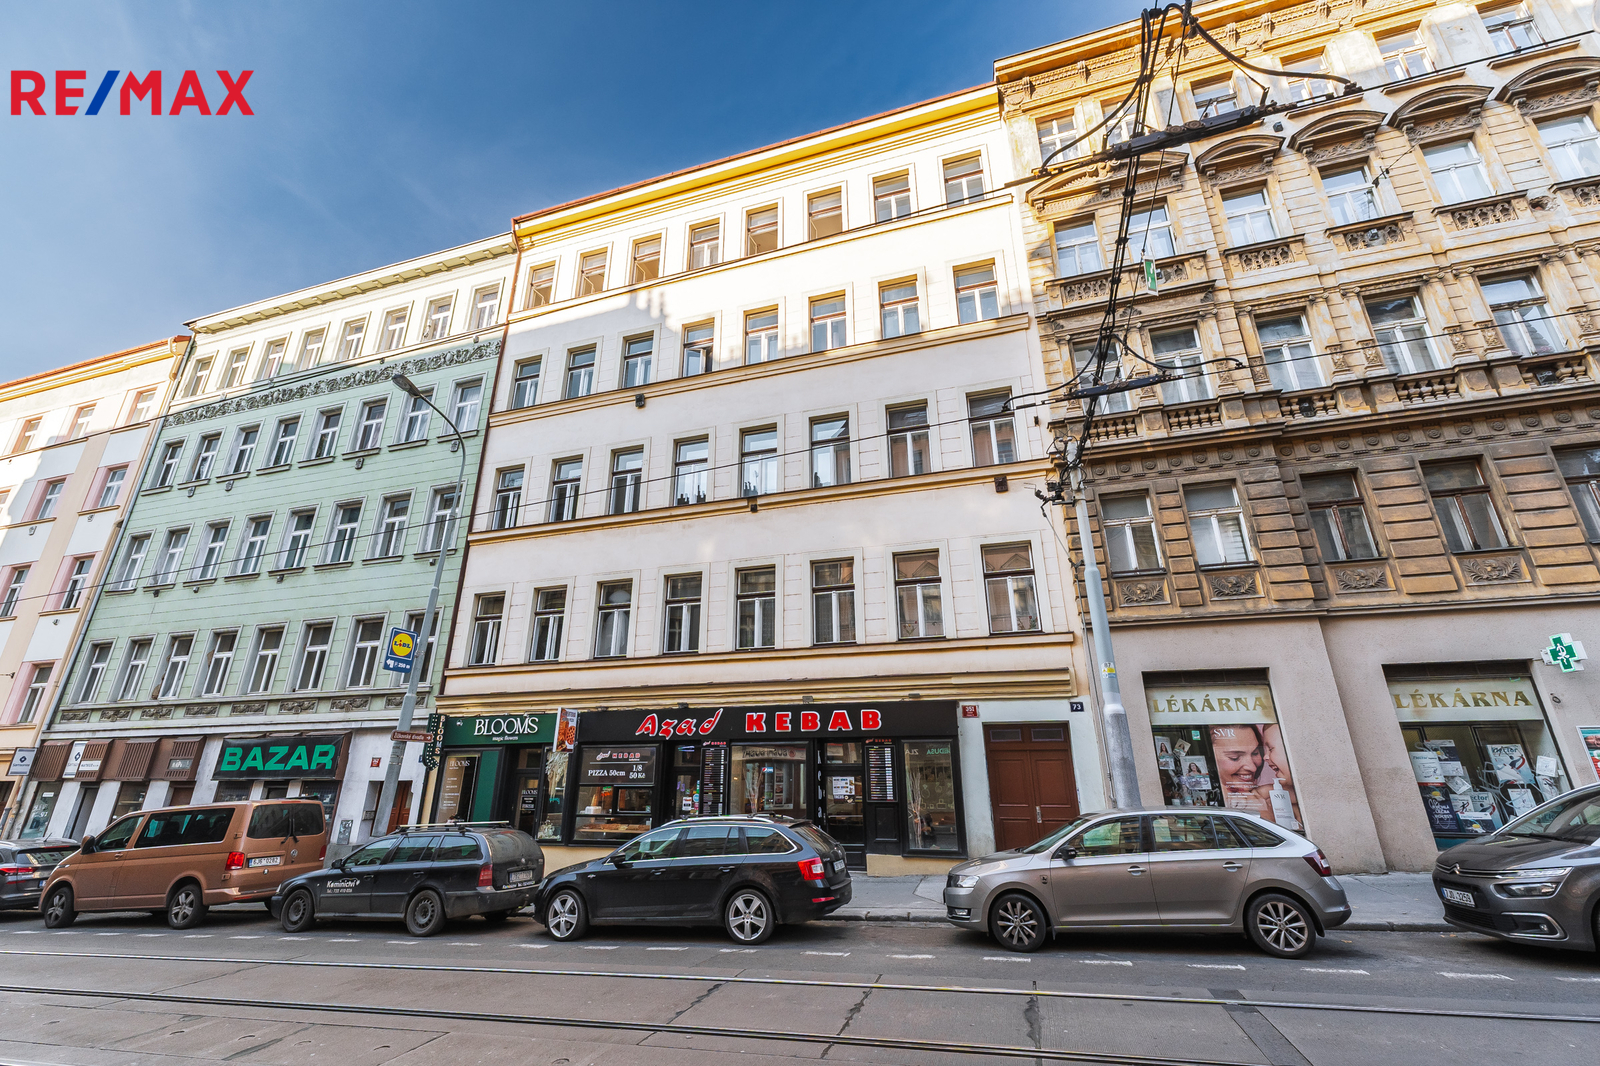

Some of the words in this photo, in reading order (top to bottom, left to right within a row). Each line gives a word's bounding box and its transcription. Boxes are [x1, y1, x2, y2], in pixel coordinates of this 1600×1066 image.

[1153, 693, 1267, 713] LÉKÁRNA
[1393, 687, 1533, 709] LÉKÁRNA
[473, 716, 539, 736] BLOOMS
[635, 708, 724, 740] Azad
[745, 709, 882, 733] KEBAB
[1213, 728, 1236, 738] SVR
[220, 744, 336, 771] BAZAR
[588, 769, 608, 777] PIZZA
[609, 769, 626, 777] 50cm
[632, 764, 643, 772] 1/8
